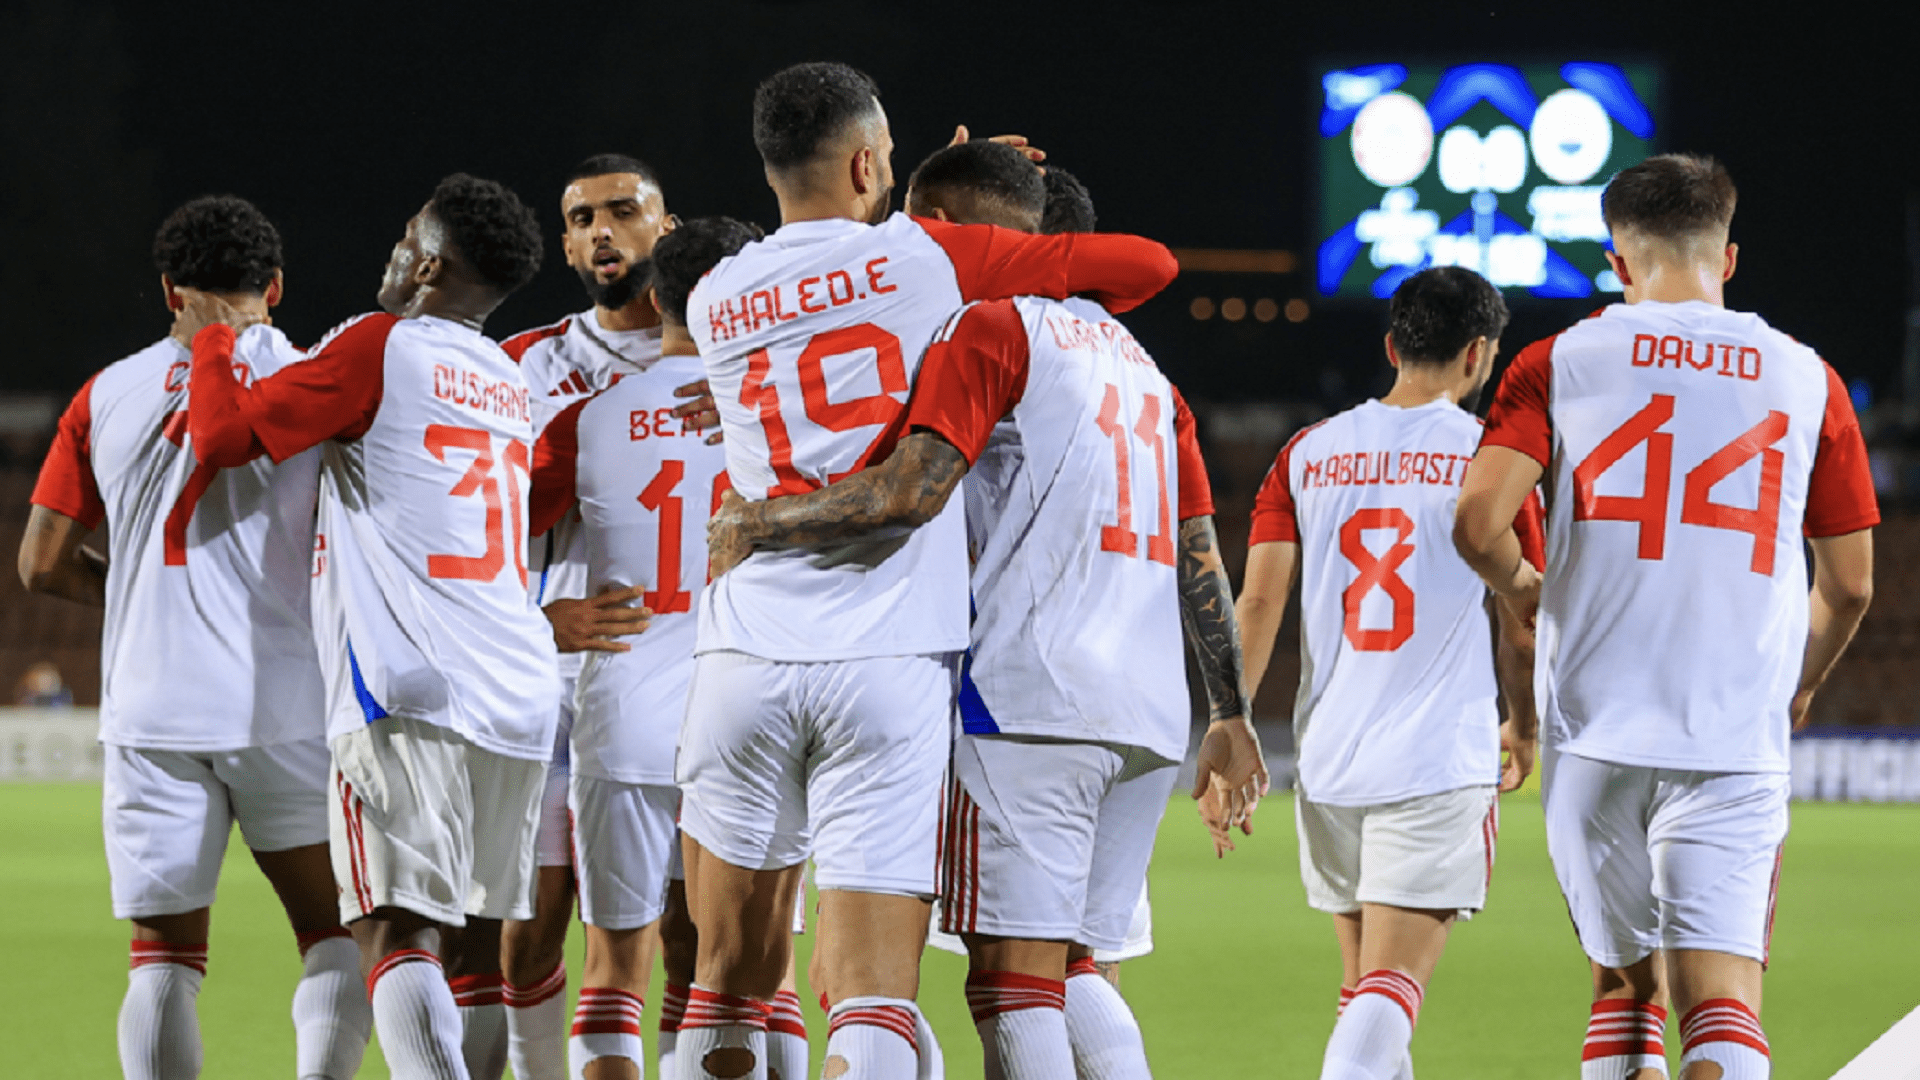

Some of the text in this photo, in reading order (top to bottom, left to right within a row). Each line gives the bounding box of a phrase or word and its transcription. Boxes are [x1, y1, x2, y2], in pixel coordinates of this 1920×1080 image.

[708, 256, 898, 343] KHALED.E
[1631, 334, 1762, 381] DAVID
[738, 322, 909, 499] 19
[1094, 382, 1178, 568] 11
[1573, 393, 1790, 577] 44
[1339, 507, 1415, 653] 8
